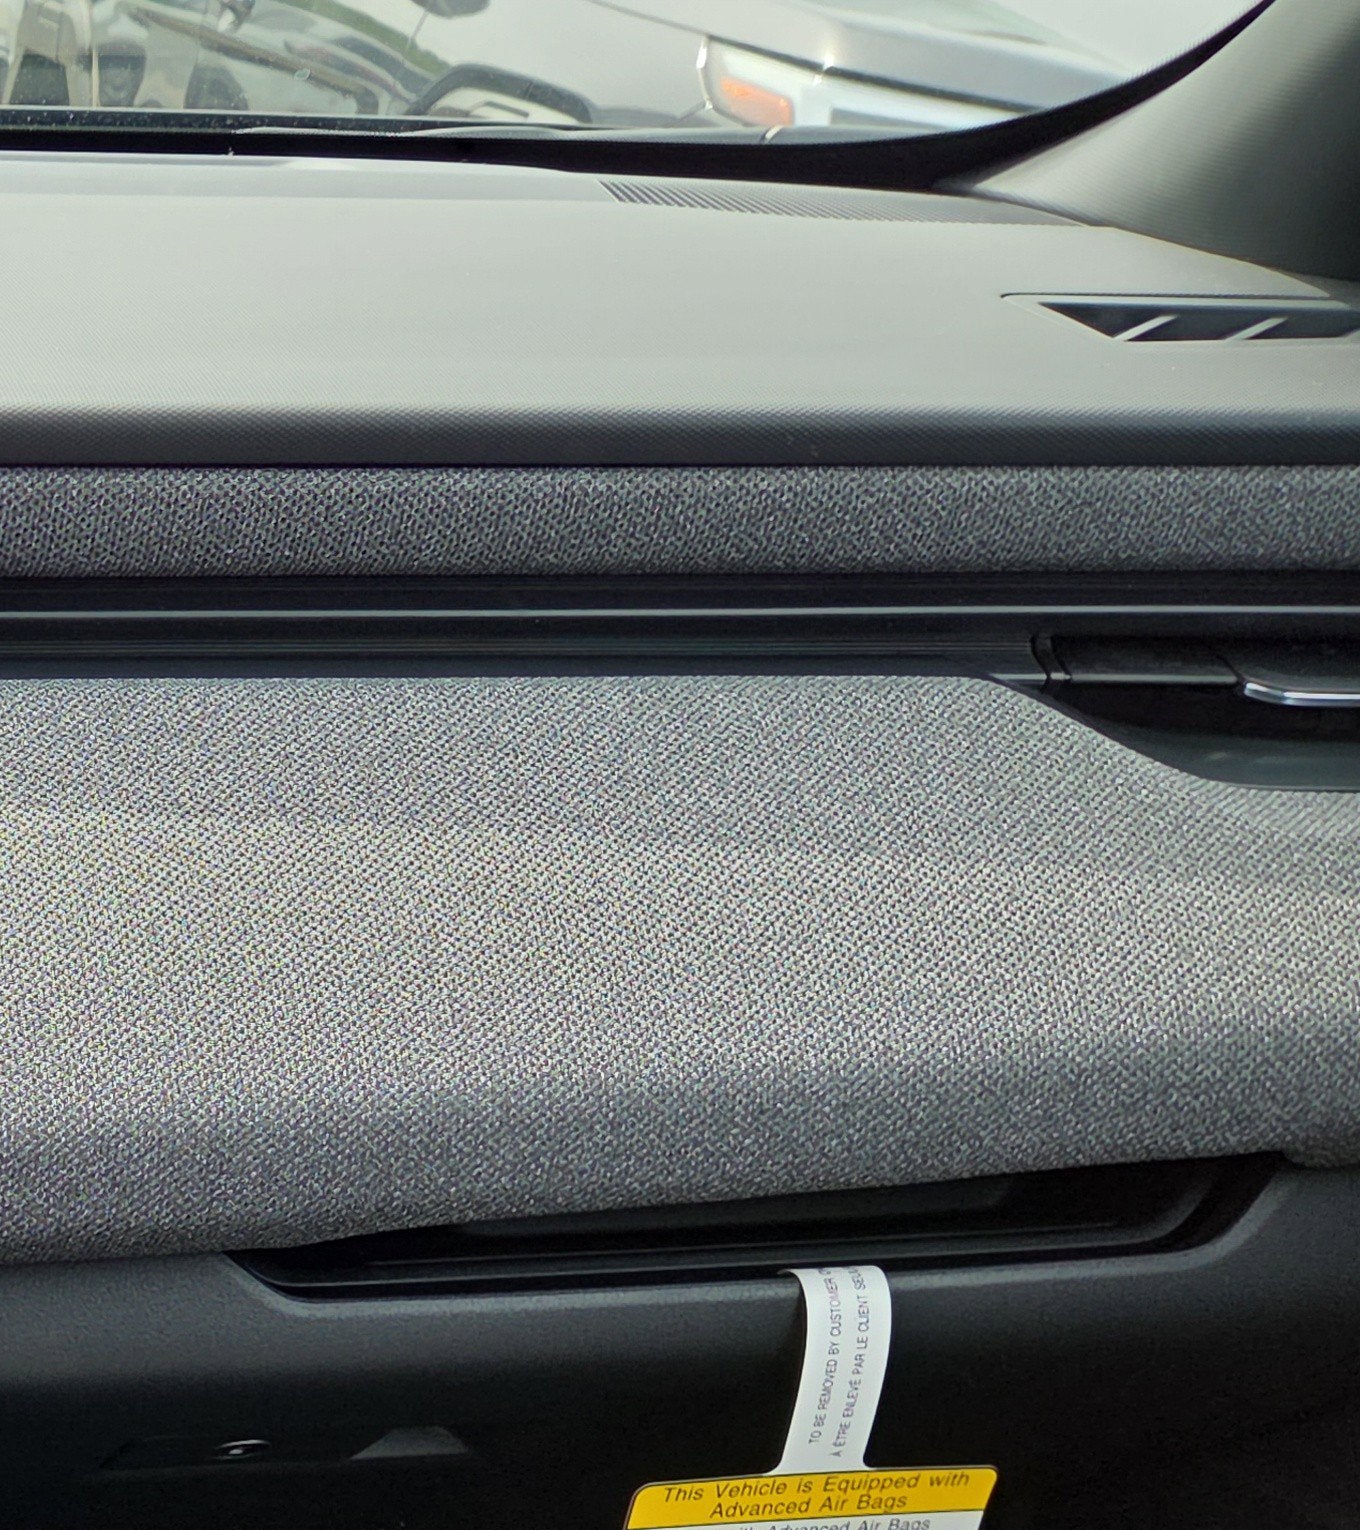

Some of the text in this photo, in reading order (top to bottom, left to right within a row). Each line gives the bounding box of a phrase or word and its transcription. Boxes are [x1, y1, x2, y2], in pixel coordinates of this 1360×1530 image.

[828, 1342, 840, 1356] BY
[857, 1335, 869, 1350] LE
[852, 1353, 864, 1375] PAR
[818, 1360, 837, 1412] REMOVED
[814, 1412, 827, 1427] BE
[809, 1426, 822, 1443] TO
[664, 1473, 970, 1502] This Vehicle is Equipped with
[710, 1494, 908, 1518] Advanced Air Bags
